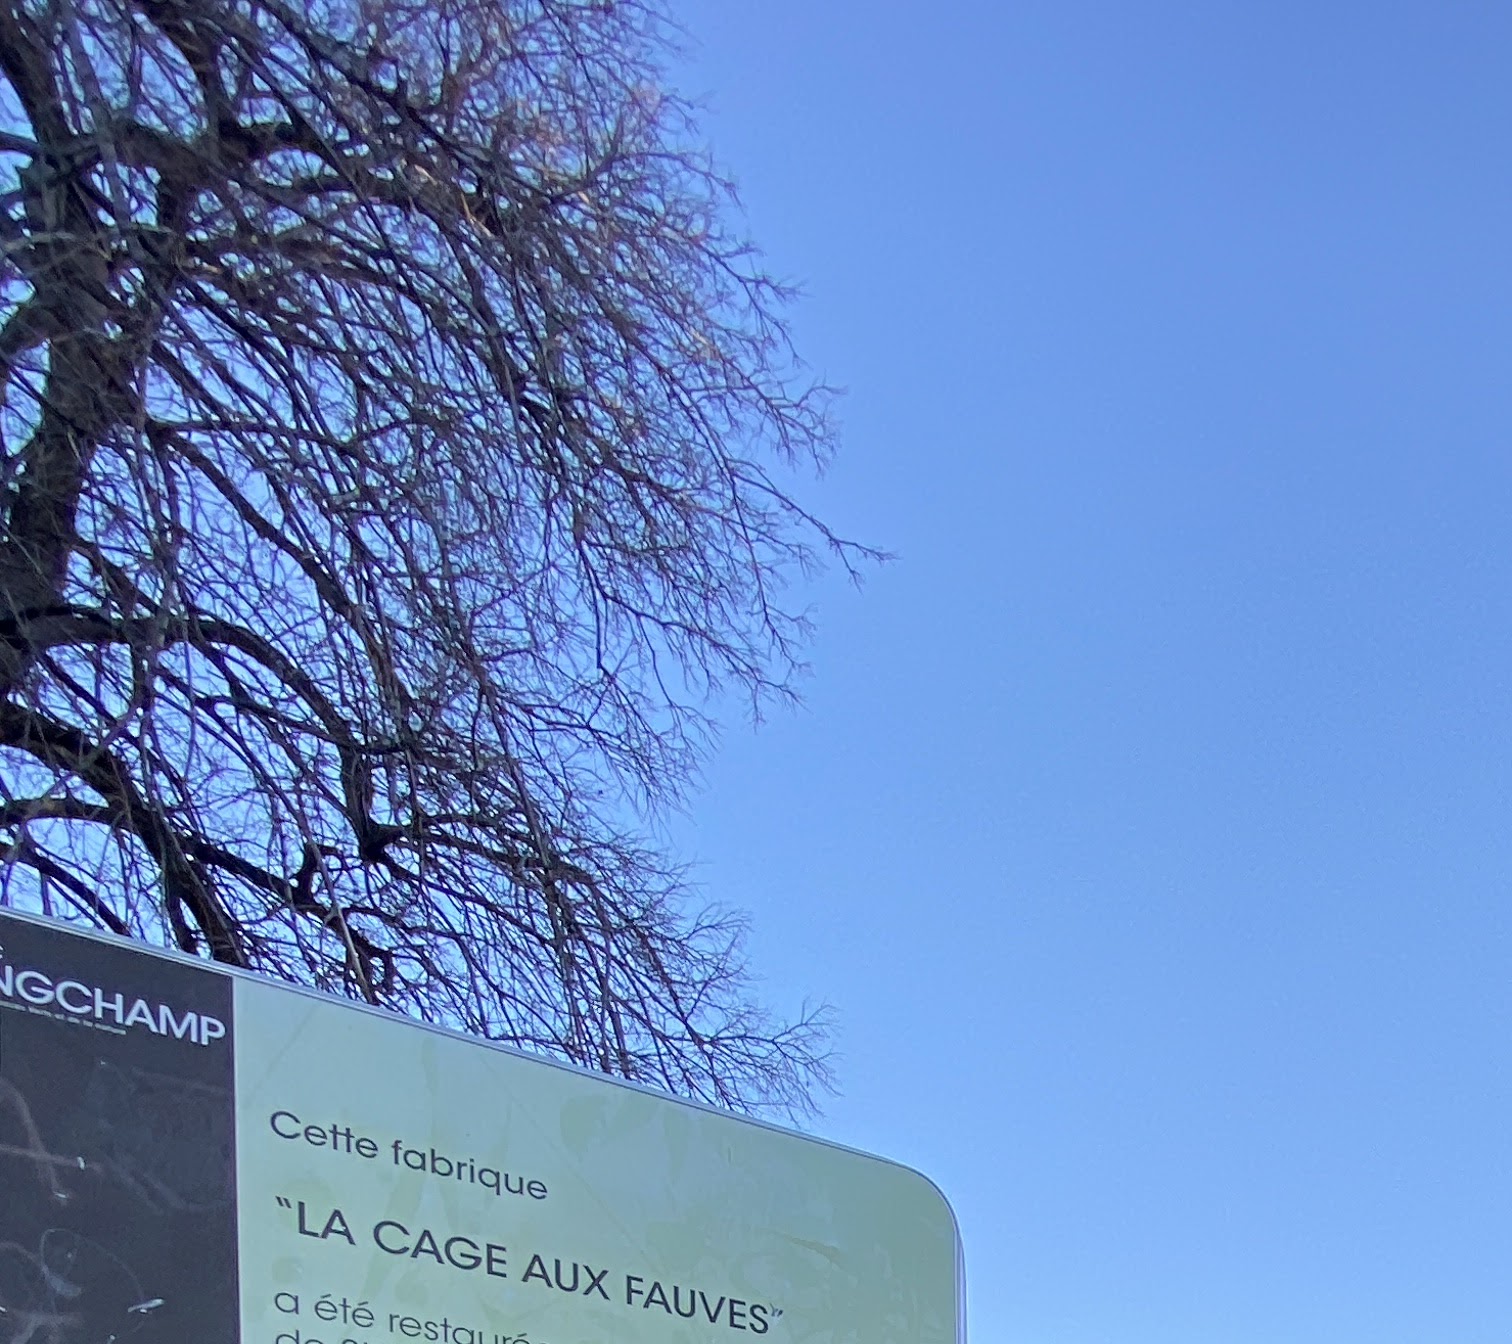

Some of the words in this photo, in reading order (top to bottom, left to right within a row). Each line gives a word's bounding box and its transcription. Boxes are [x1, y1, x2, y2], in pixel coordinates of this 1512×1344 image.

[270, 1111, 378, 1159] Cette
[391, 1139, 548, 1200] fabrique
[373, 1220, 507, 1278] CAGE
[521, 1254, 611, 1301] AUX
[274, 1292, 300, 1315] a
[314, 1293, 374, 1328] été
